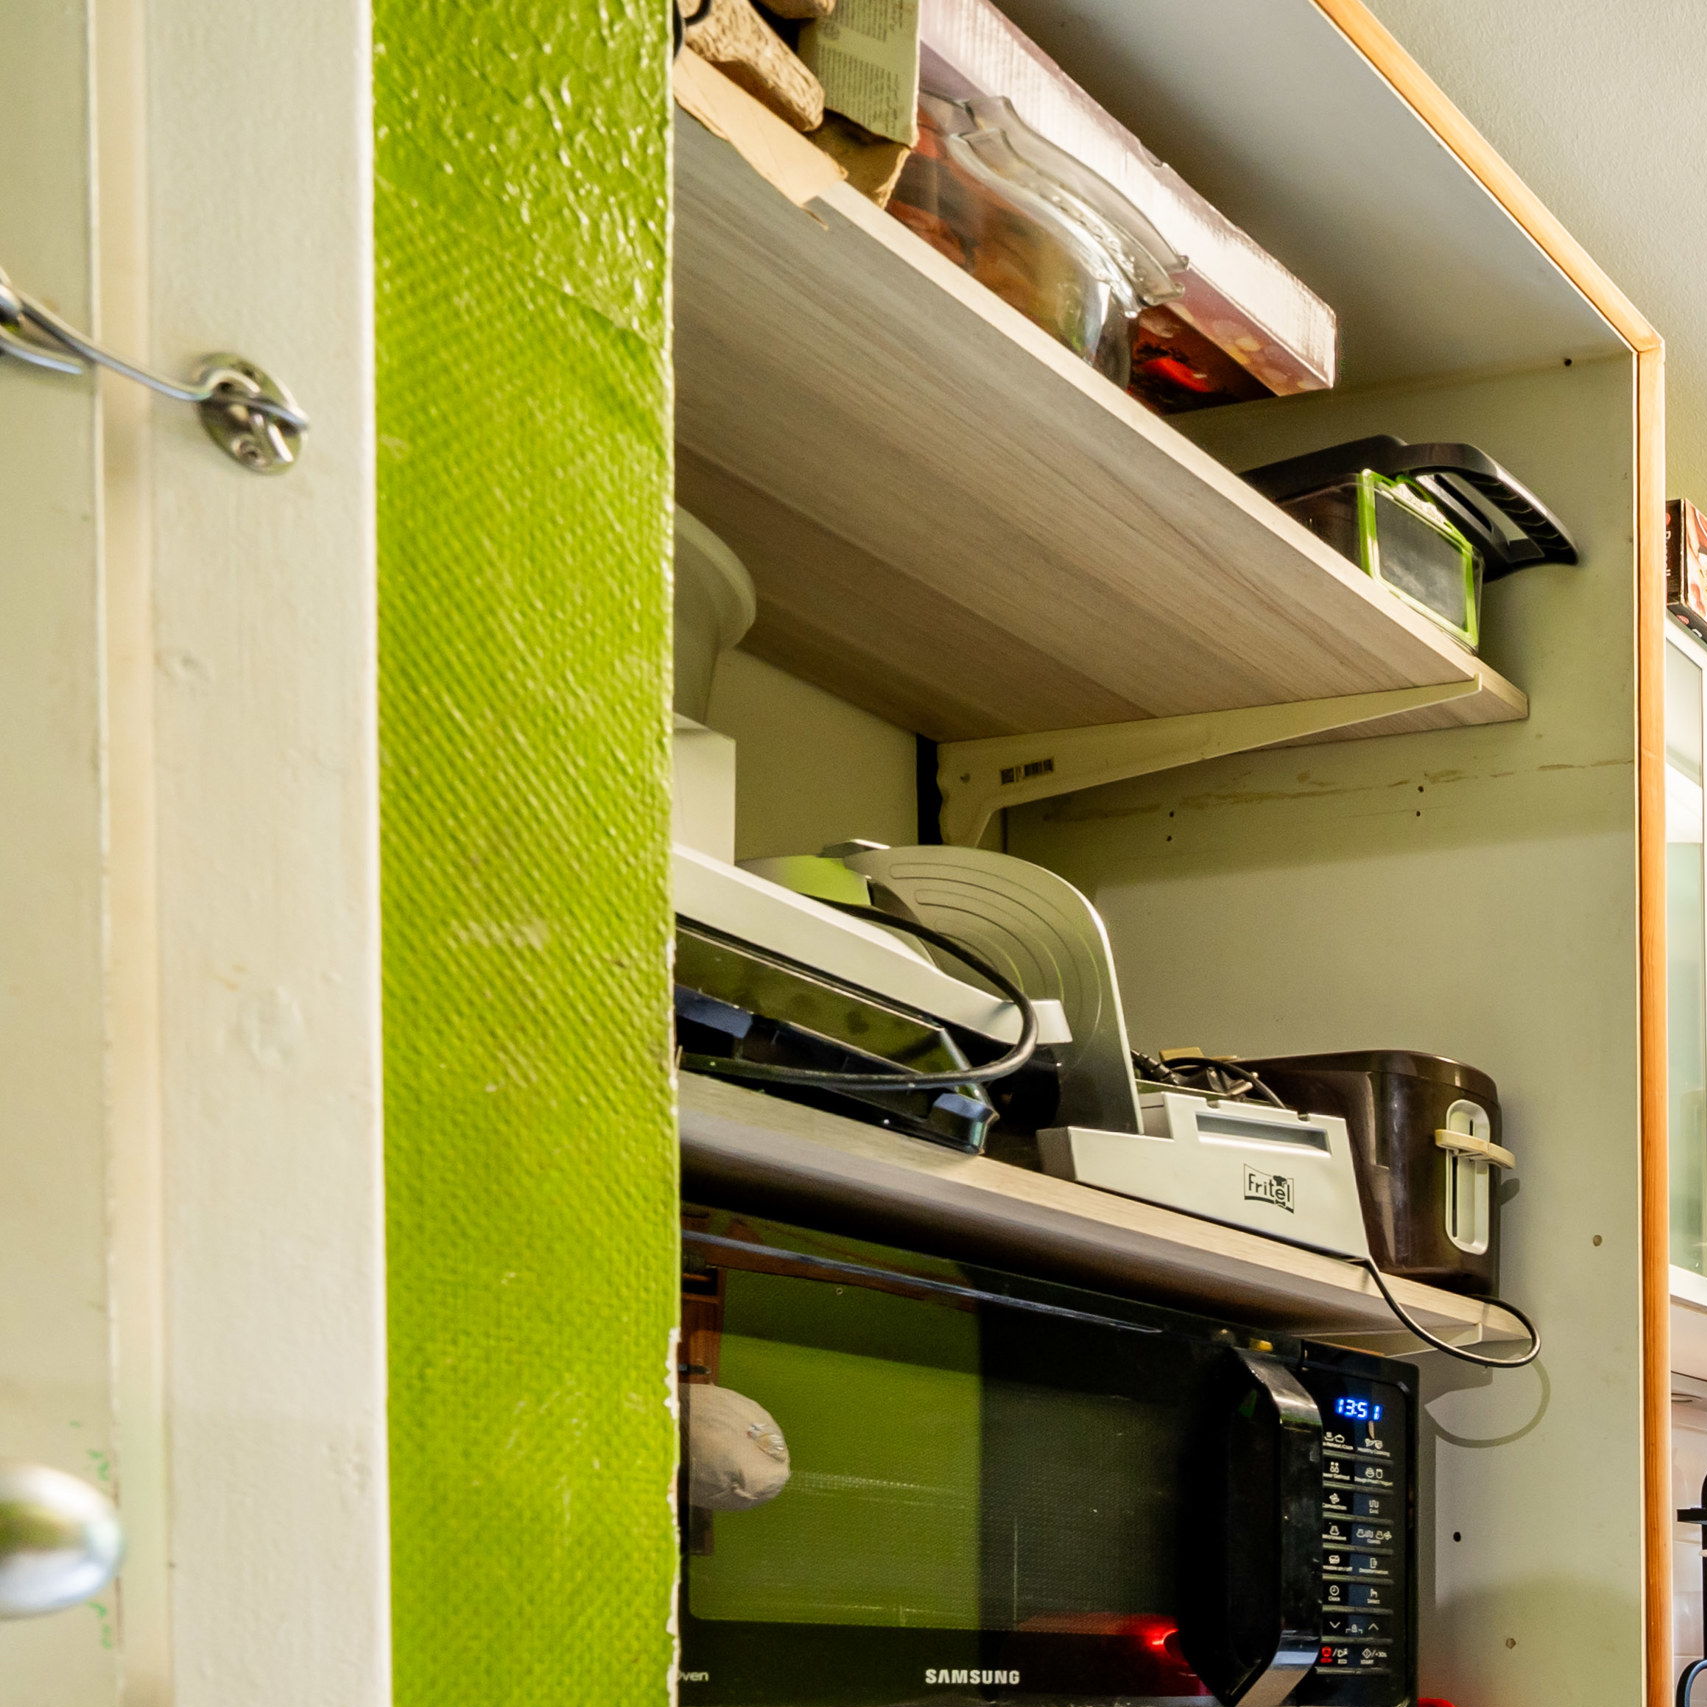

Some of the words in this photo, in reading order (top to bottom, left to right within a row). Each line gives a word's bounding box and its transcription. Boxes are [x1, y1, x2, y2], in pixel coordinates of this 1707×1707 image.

[1248, 1173, 1291, 1202] Fritel
[1335, 1399, 1381, 1421] 13:51
[924, 1668, 1021, 1685] SAMSUNG
